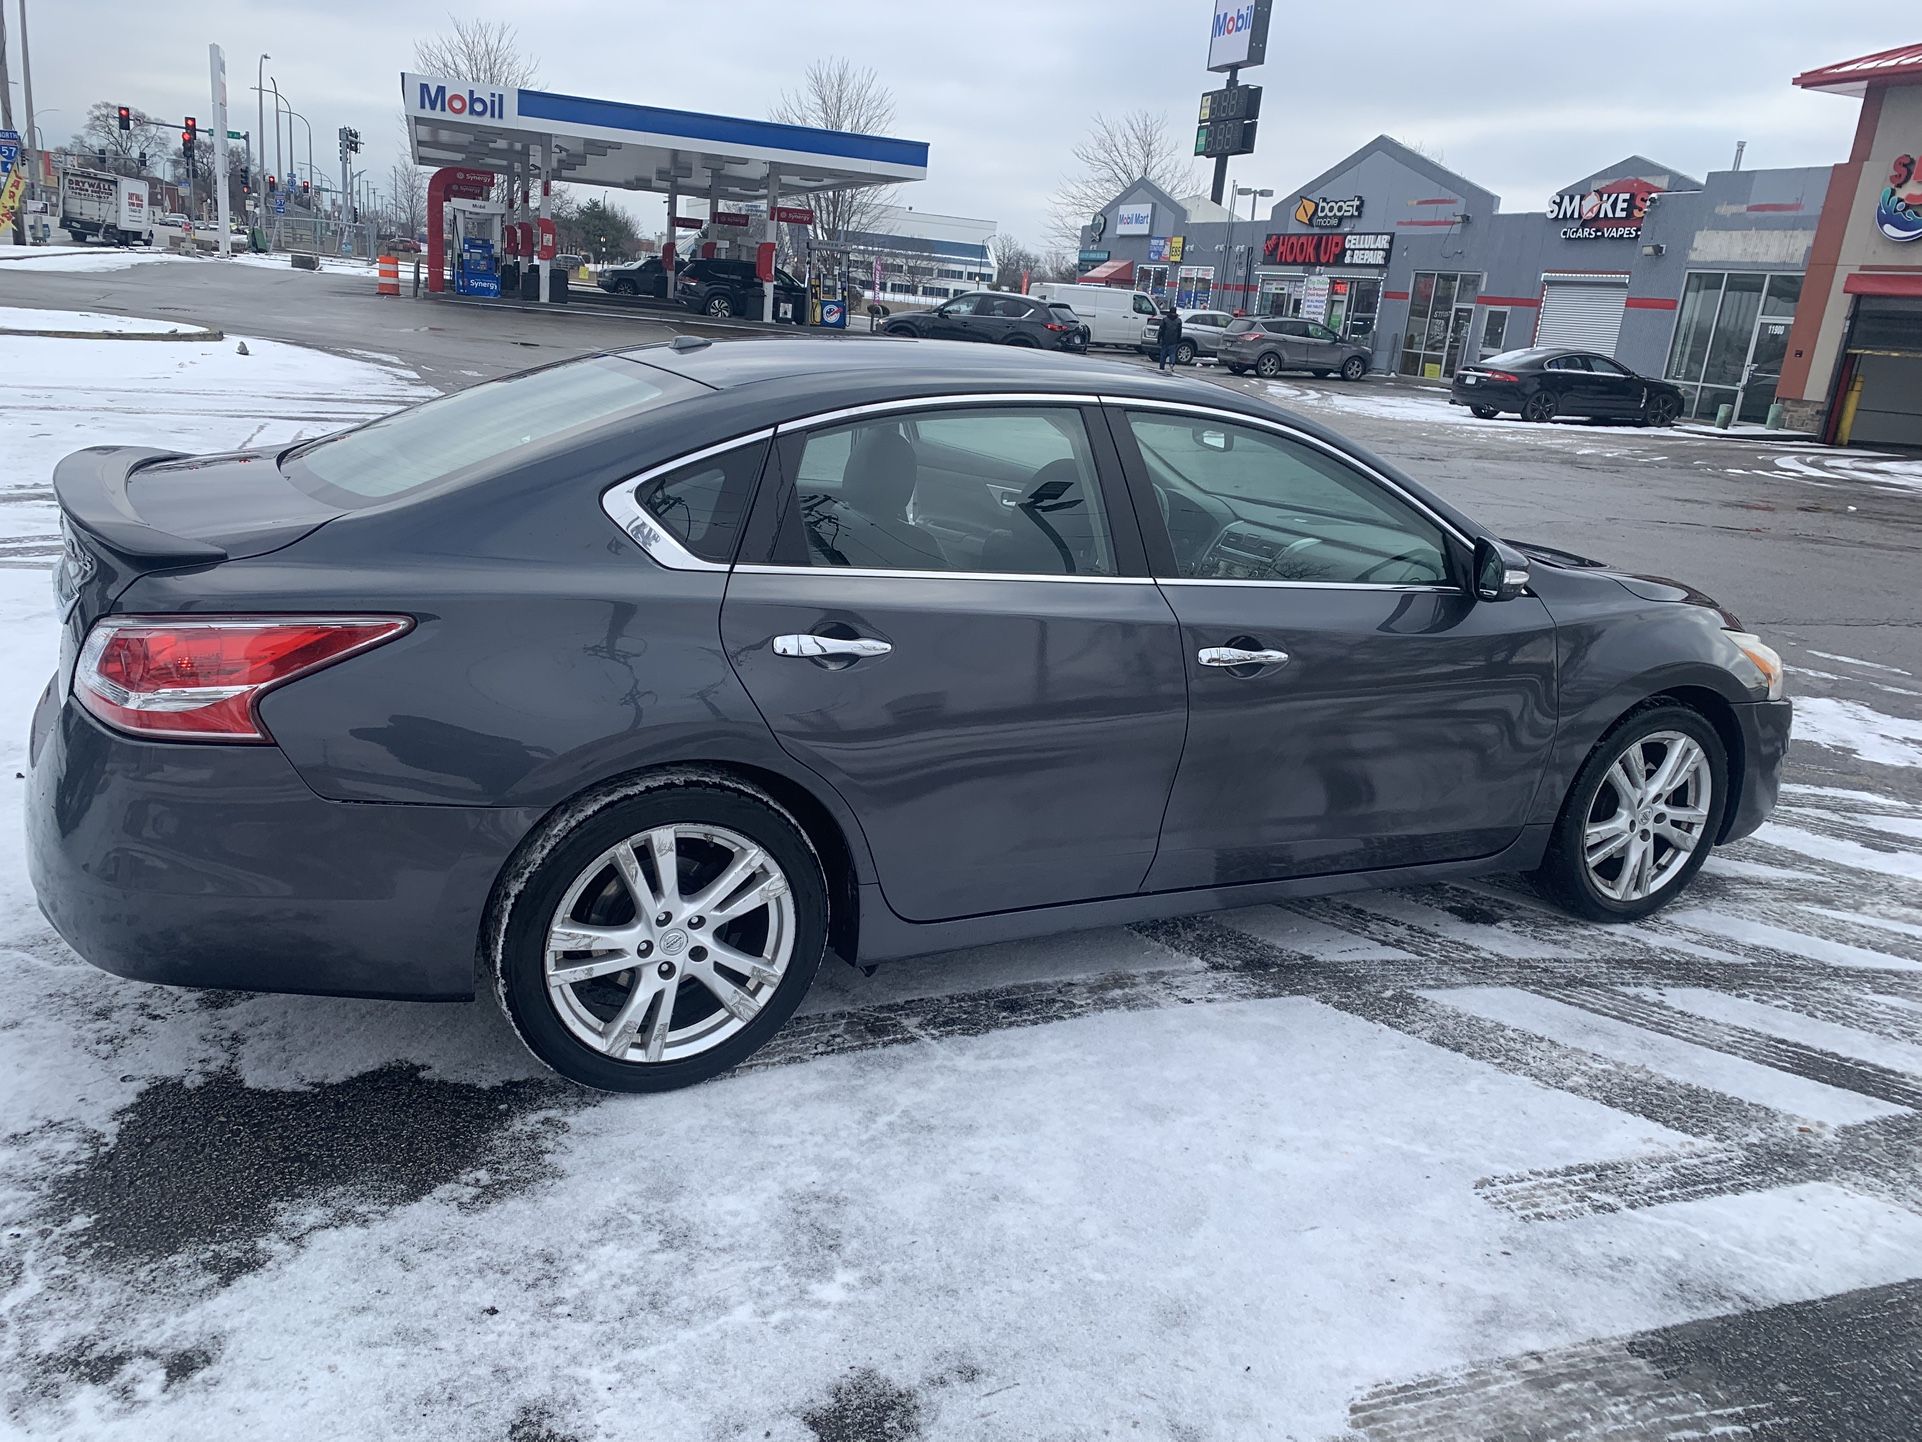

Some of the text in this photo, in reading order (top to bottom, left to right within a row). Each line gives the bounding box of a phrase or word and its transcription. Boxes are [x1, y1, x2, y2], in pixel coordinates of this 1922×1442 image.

[1214, 5, 1253, 38] Mobil
[420, 83, 504, 119] Mobil
[2, 147, 16, 156] 57
[466, 173, 491, 183] Synergy
[68, 179, 113, 192] DRYWALL
[1318, 198, 1361, 217] boost
[1546, 191, 1631, 219] SMOKE
[788, 213, 811, 222] Synergy
[1119, 212, 1149, 225] Mobil Mart
[1316, 217, 1339, 226] mobile
[1560, 228, 1596, 239] CIGARS
[1603, 227, 1637, 238] VAPES
[1264, 235, 1279, 256] The
[1344, 234, 1391, 249] CELLULAR
[1277, 235, 1345, 263] HOOK UP
[1344, 250, 1387, 264] & REPAIR
[470, 279, 498, 290] Synergy
[1768, 325, 1785, 335] 11900
